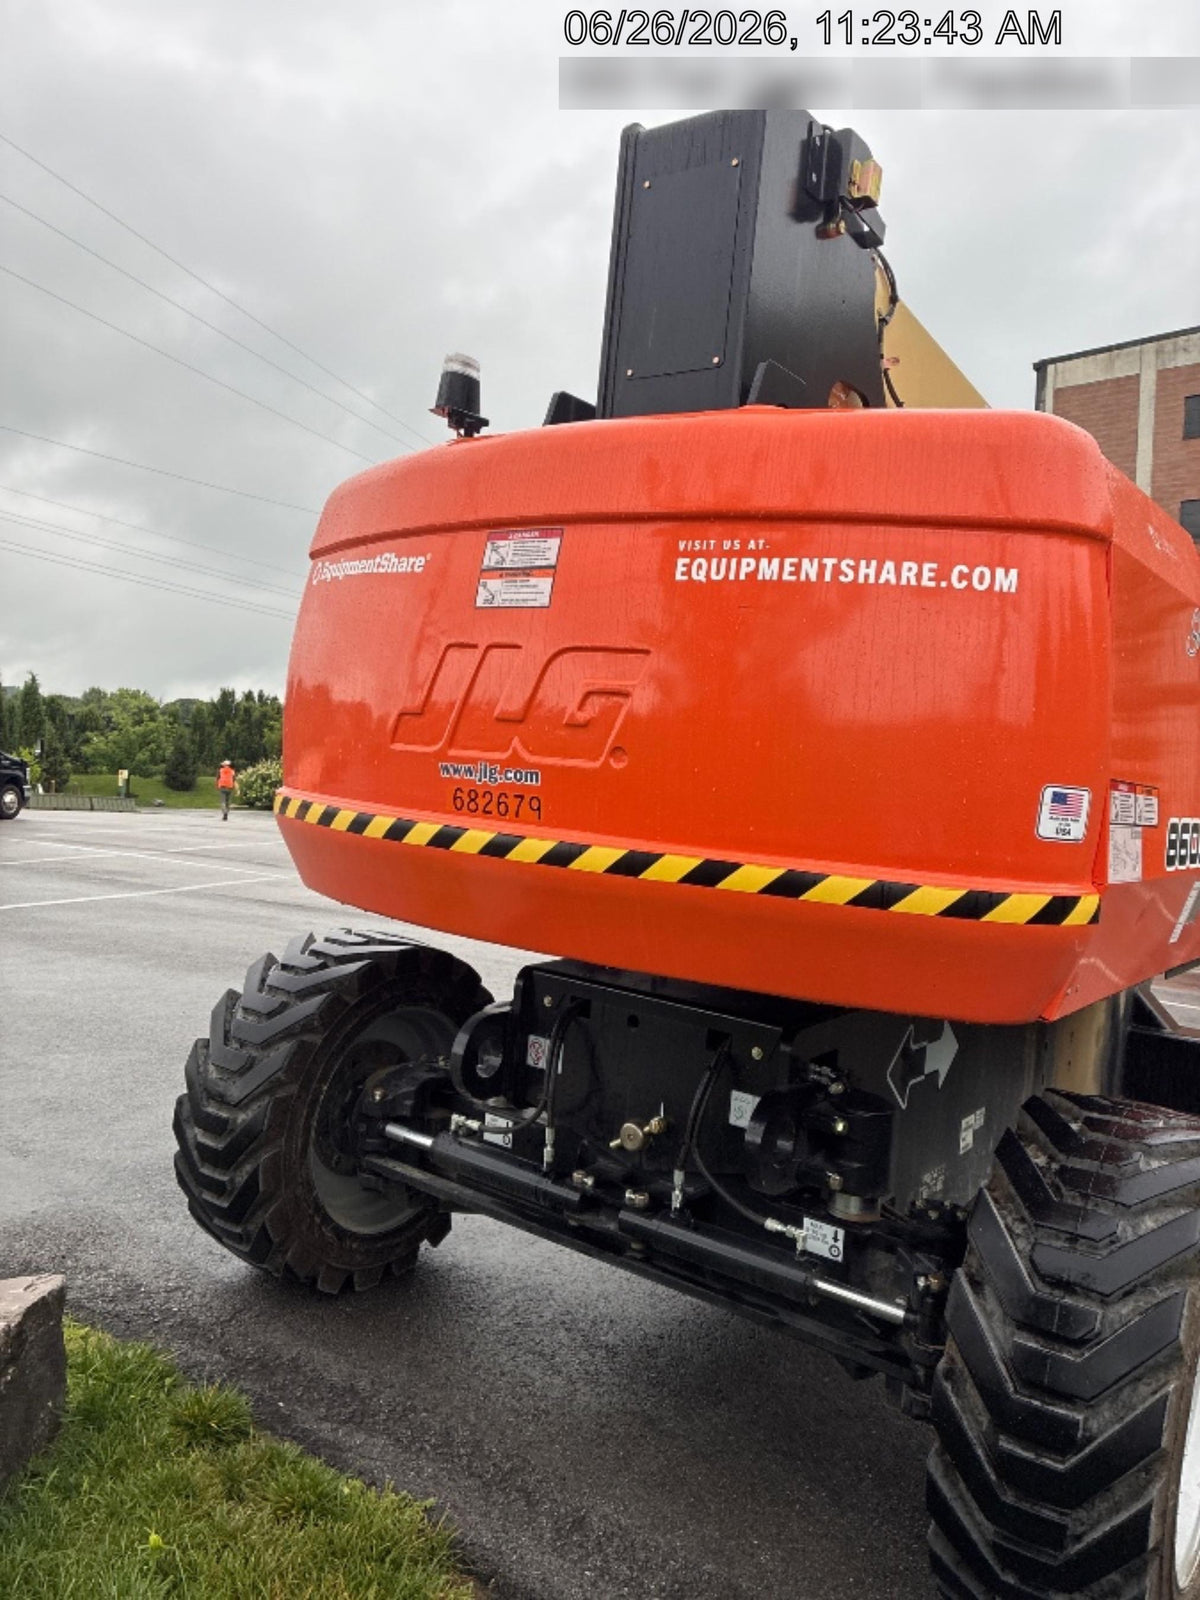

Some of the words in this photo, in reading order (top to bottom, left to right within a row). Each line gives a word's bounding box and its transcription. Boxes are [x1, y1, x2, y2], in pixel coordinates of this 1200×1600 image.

[678, 539, 716, 551] VISIT
[722, 539, 741, 551] US
[674, 557, 1019, 593] EQUIPMENTSHARE.COM
[439, 761, 541, 786] www.jlg.com
[452, 787, 542, 820] 682679
[1165, 818, 1200, 871] 860
